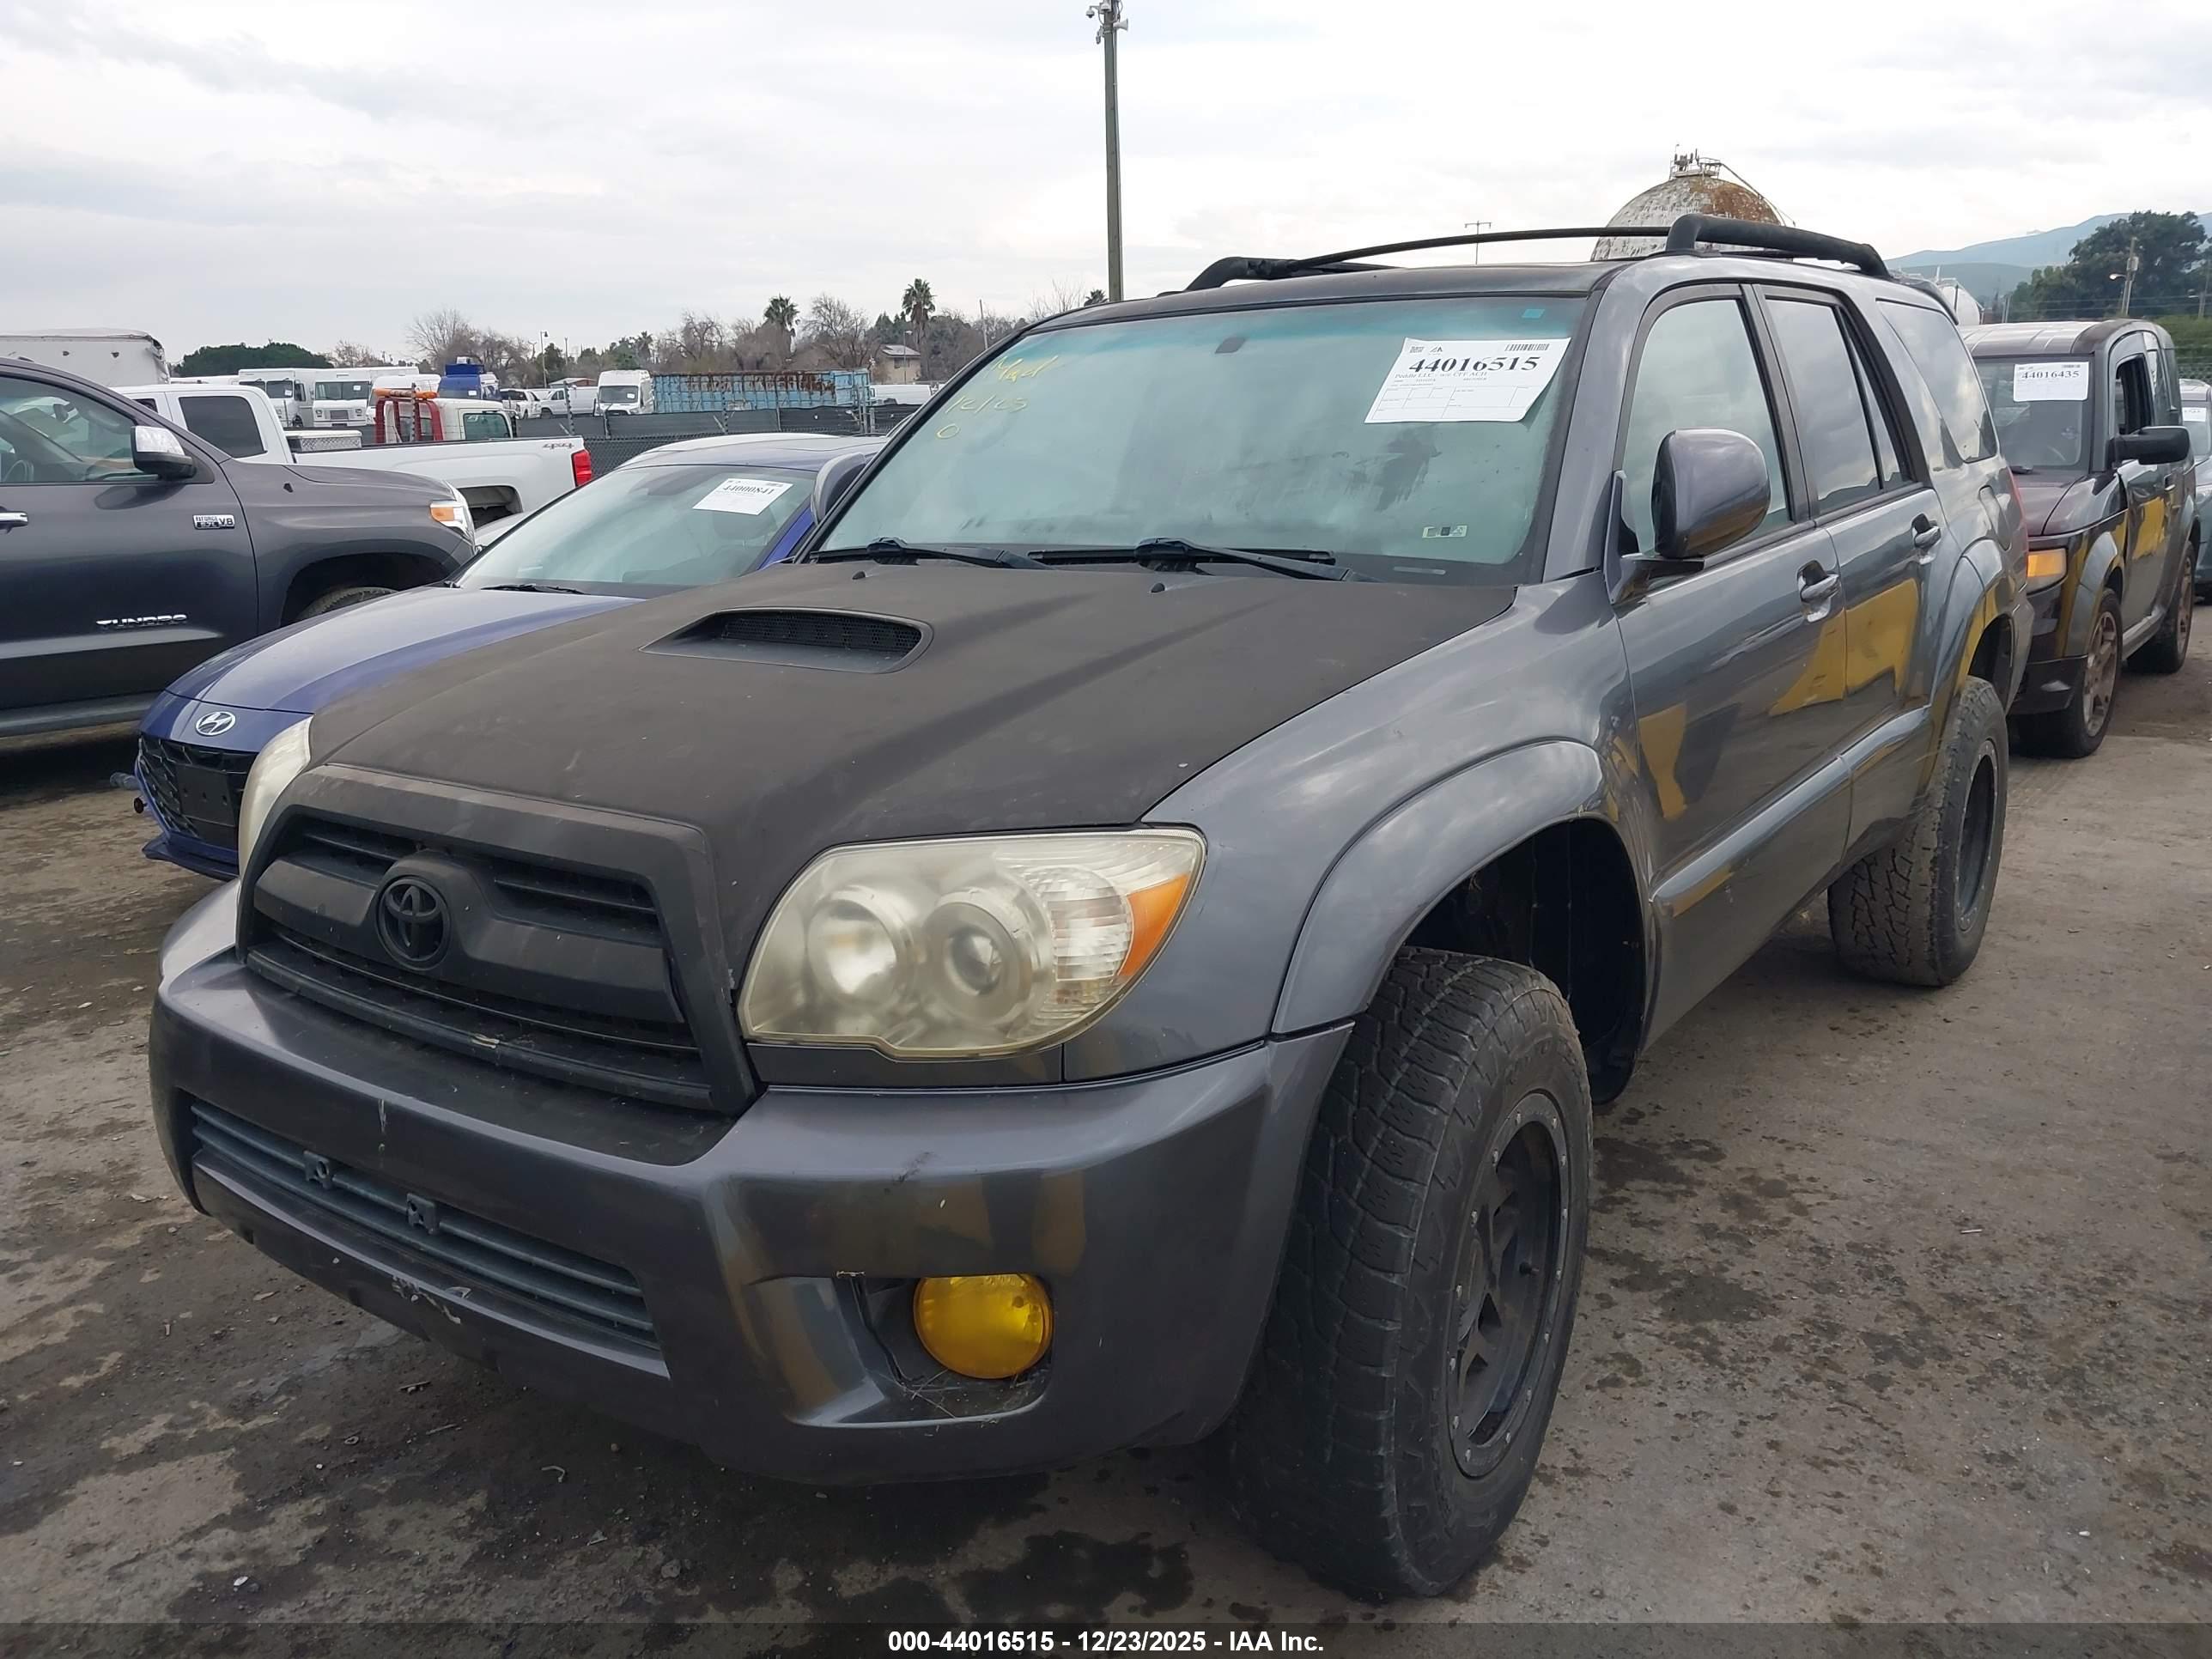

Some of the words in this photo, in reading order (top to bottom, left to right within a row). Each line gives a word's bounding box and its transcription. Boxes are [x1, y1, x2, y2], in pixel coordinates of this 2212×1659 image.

[1408, 356, 1540, 373] 44016515
[2021, 370, 2080, 380] 44016435
[219, 517, 234, 526] V8
